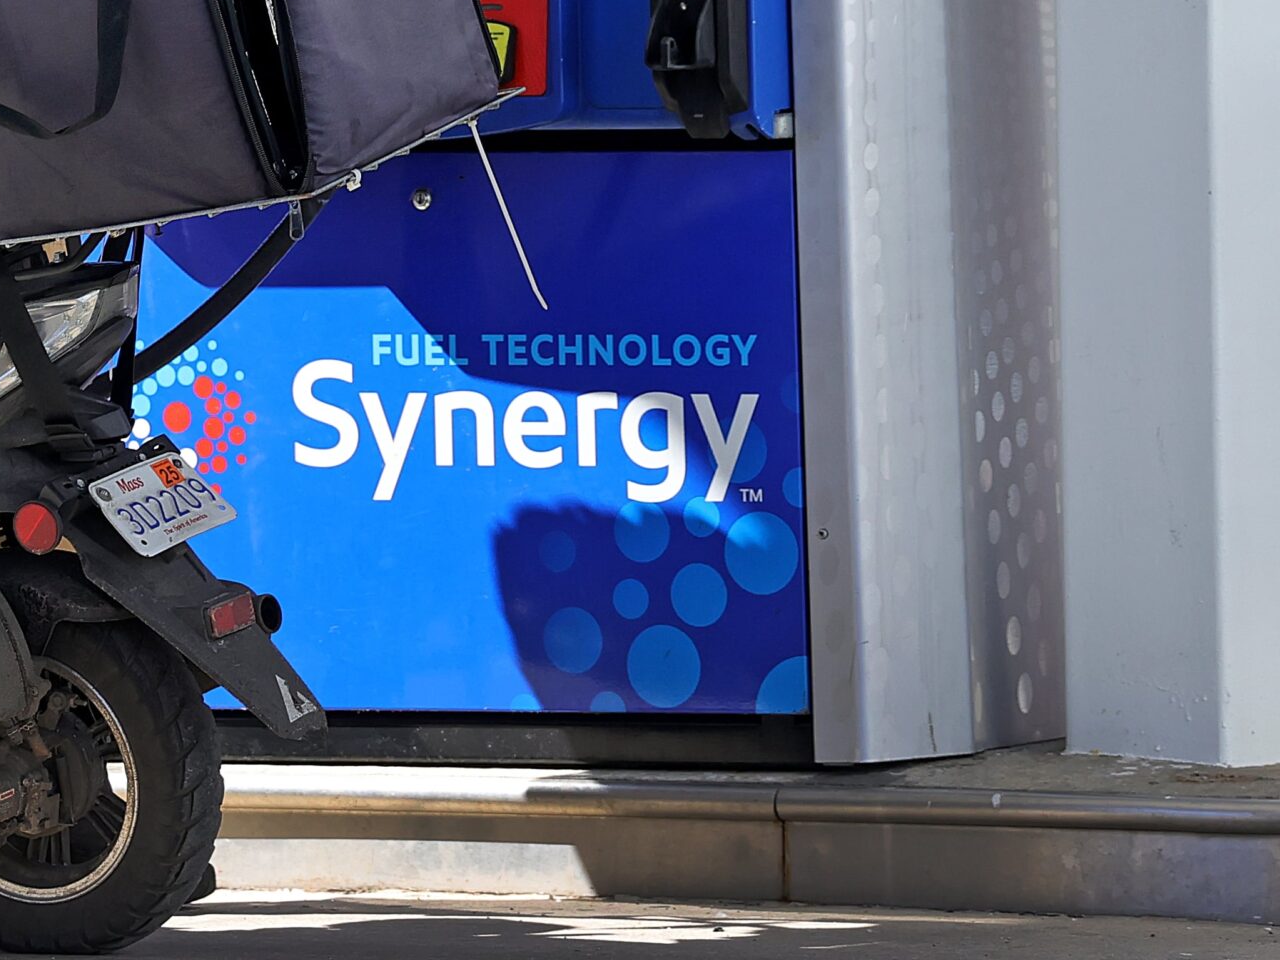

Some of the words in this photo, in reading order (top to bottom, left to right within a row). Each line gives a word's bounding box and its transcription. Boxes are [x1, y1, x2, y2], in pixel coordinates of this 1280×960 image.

[371, 334, 467, 367] FUEL
[482, 334, 758, 367] TECHNOLOGY
[291, 358, 761, 503] Synergy
[116, 476, 144, 495] Mass
[159, 466, 180, 486] 25
[117, 478, 217, 535] 3D2209
